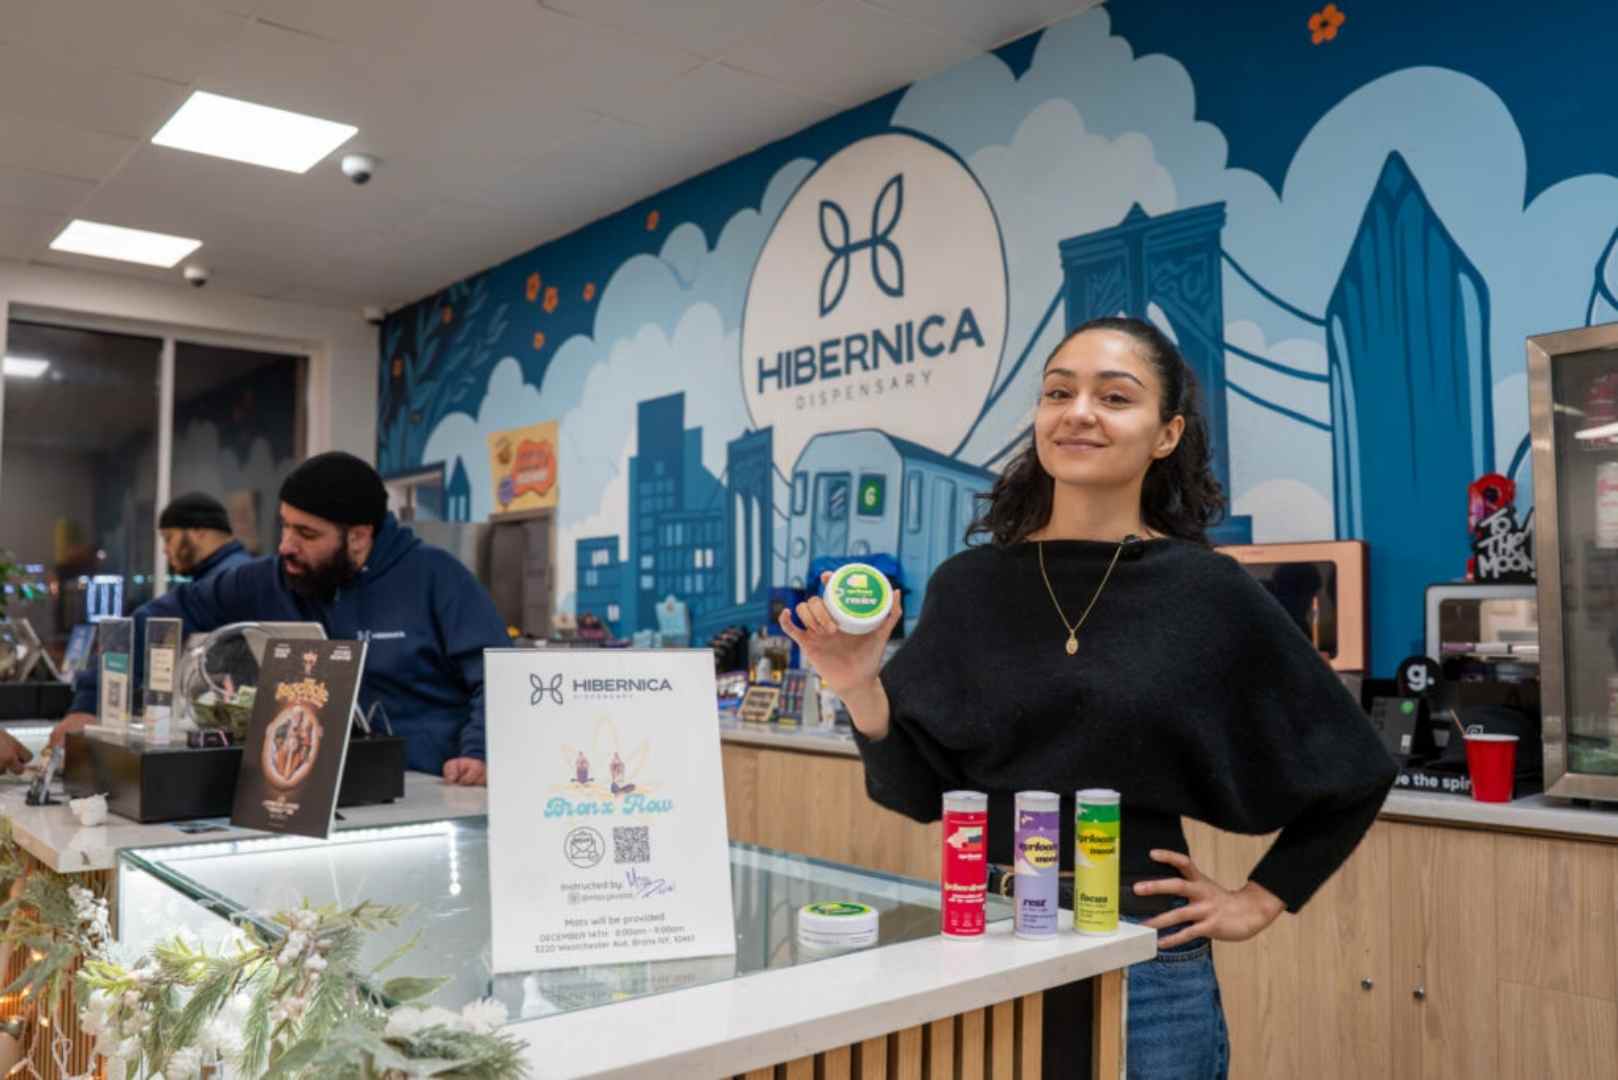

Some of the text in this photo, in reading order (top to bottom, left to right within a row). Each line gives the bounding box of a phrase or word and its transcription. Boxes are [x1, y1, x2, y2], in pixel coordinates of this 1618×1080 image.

[757, 306, 985, 395] HIBERNICA
[795, 369, 933, 412] DISPENSARY
[863, 486, 877, 507] 6
[572, 678, 673, 692] HIBERNICA
[1412, 773, 1438, 787] the
[543, 796, 616, 818] Bronx
[560, 881, 608, 891] Instructed
[1079, 893, 1108, 904] focus
[591, 915, 606, 926] will
[609, 914, 620, 925] be
[623, 912, 665, 926] provided
[539, 931, 586, 943] DECEMBER
[557, 940, 610, 953] Westchester
[631, 937, 656, 948] Bronx
